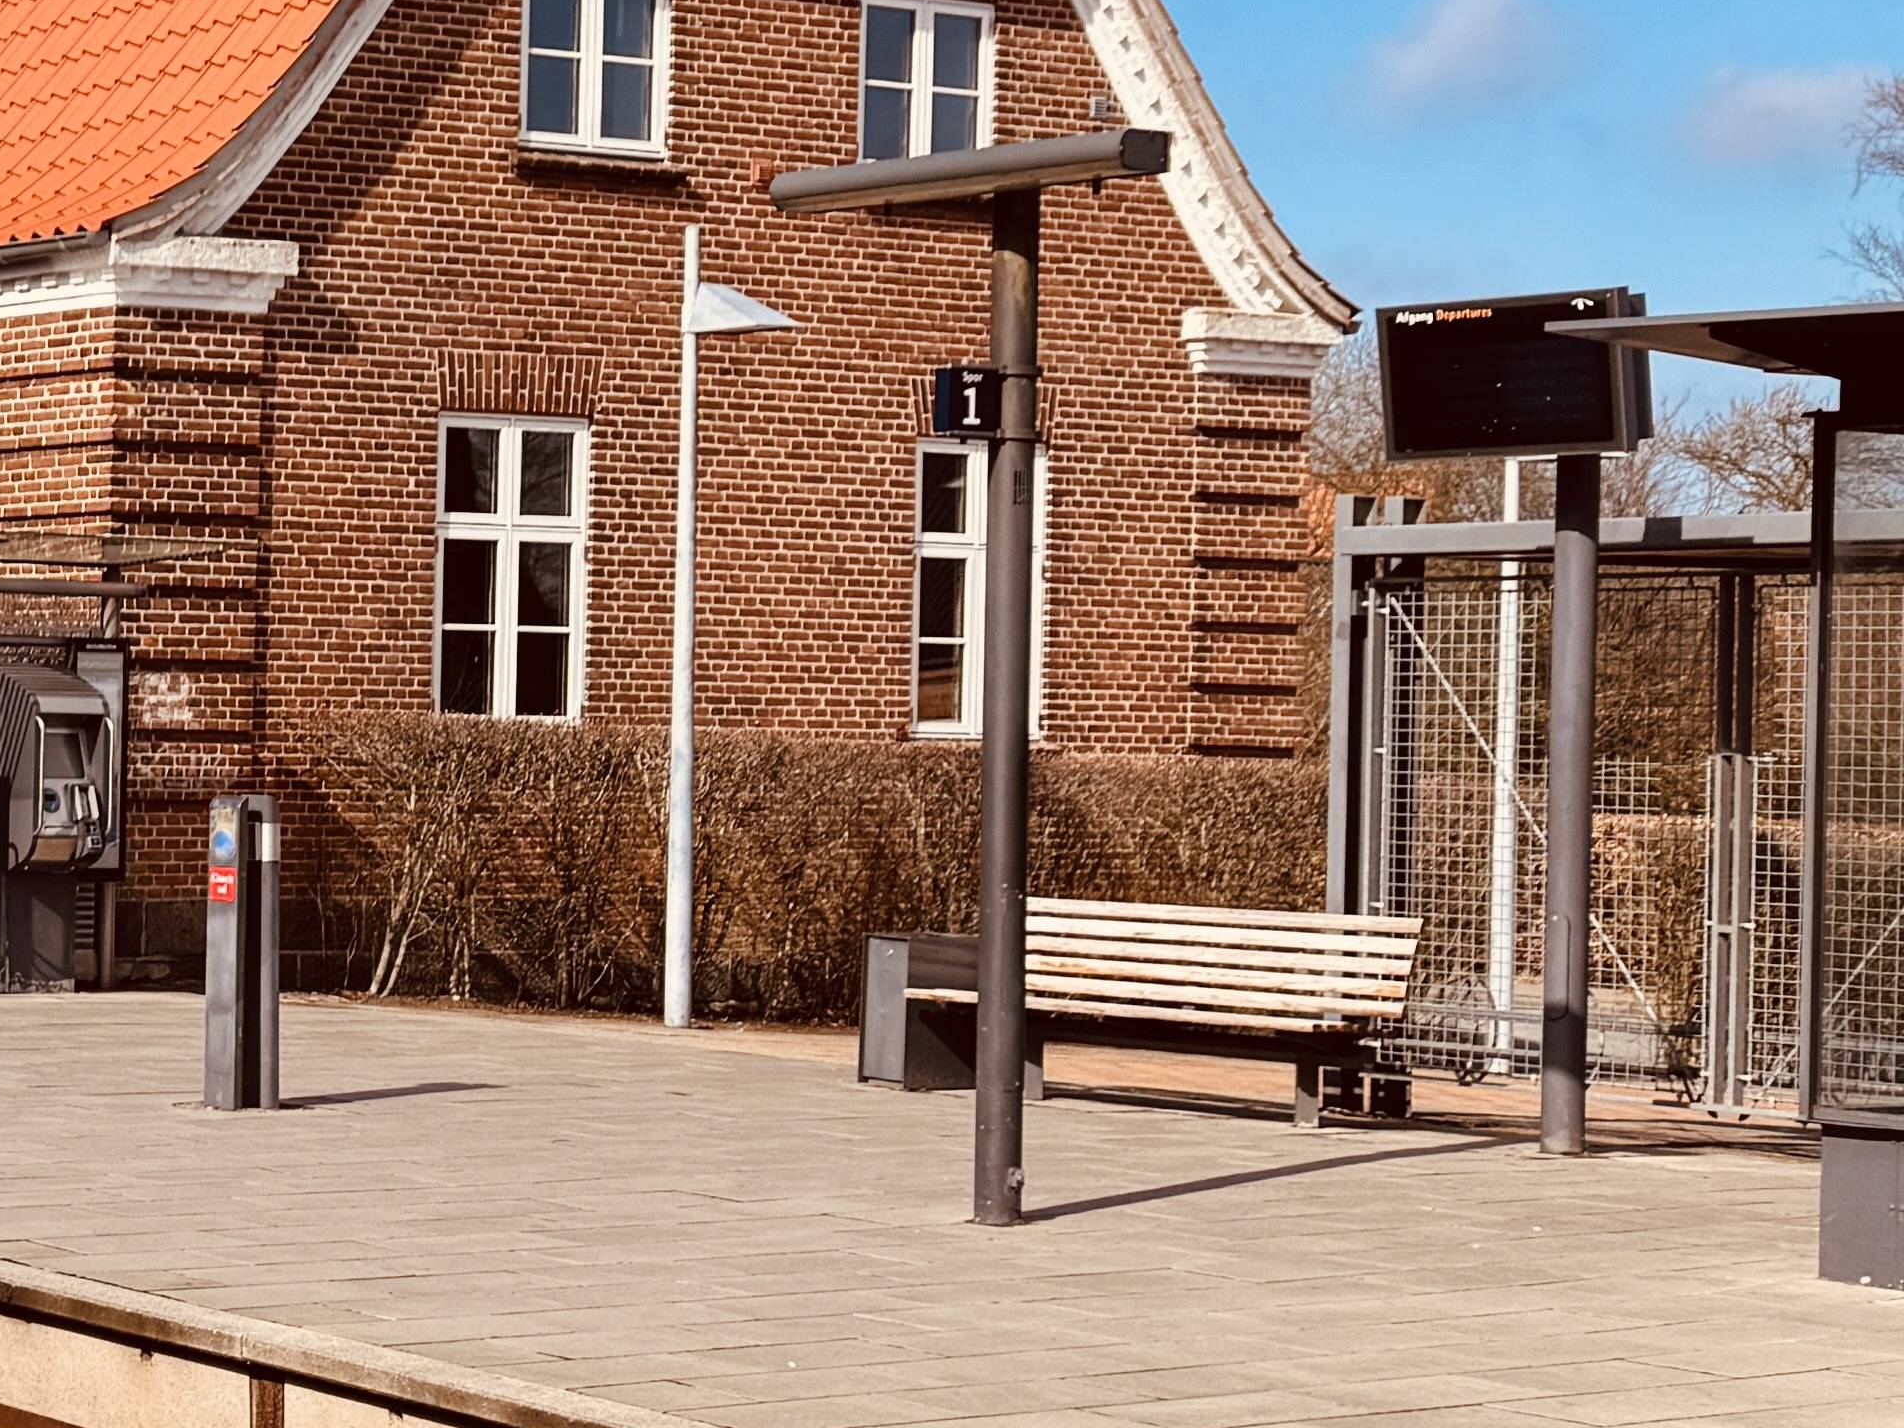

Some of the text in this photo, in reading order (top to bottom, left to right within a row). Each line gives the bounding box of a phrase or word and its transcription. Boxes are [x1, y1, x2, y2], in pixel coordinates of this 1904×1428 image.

[1395, 308, 1493, 326] Afgang Departures
[962, 386, 981, 425] 1
